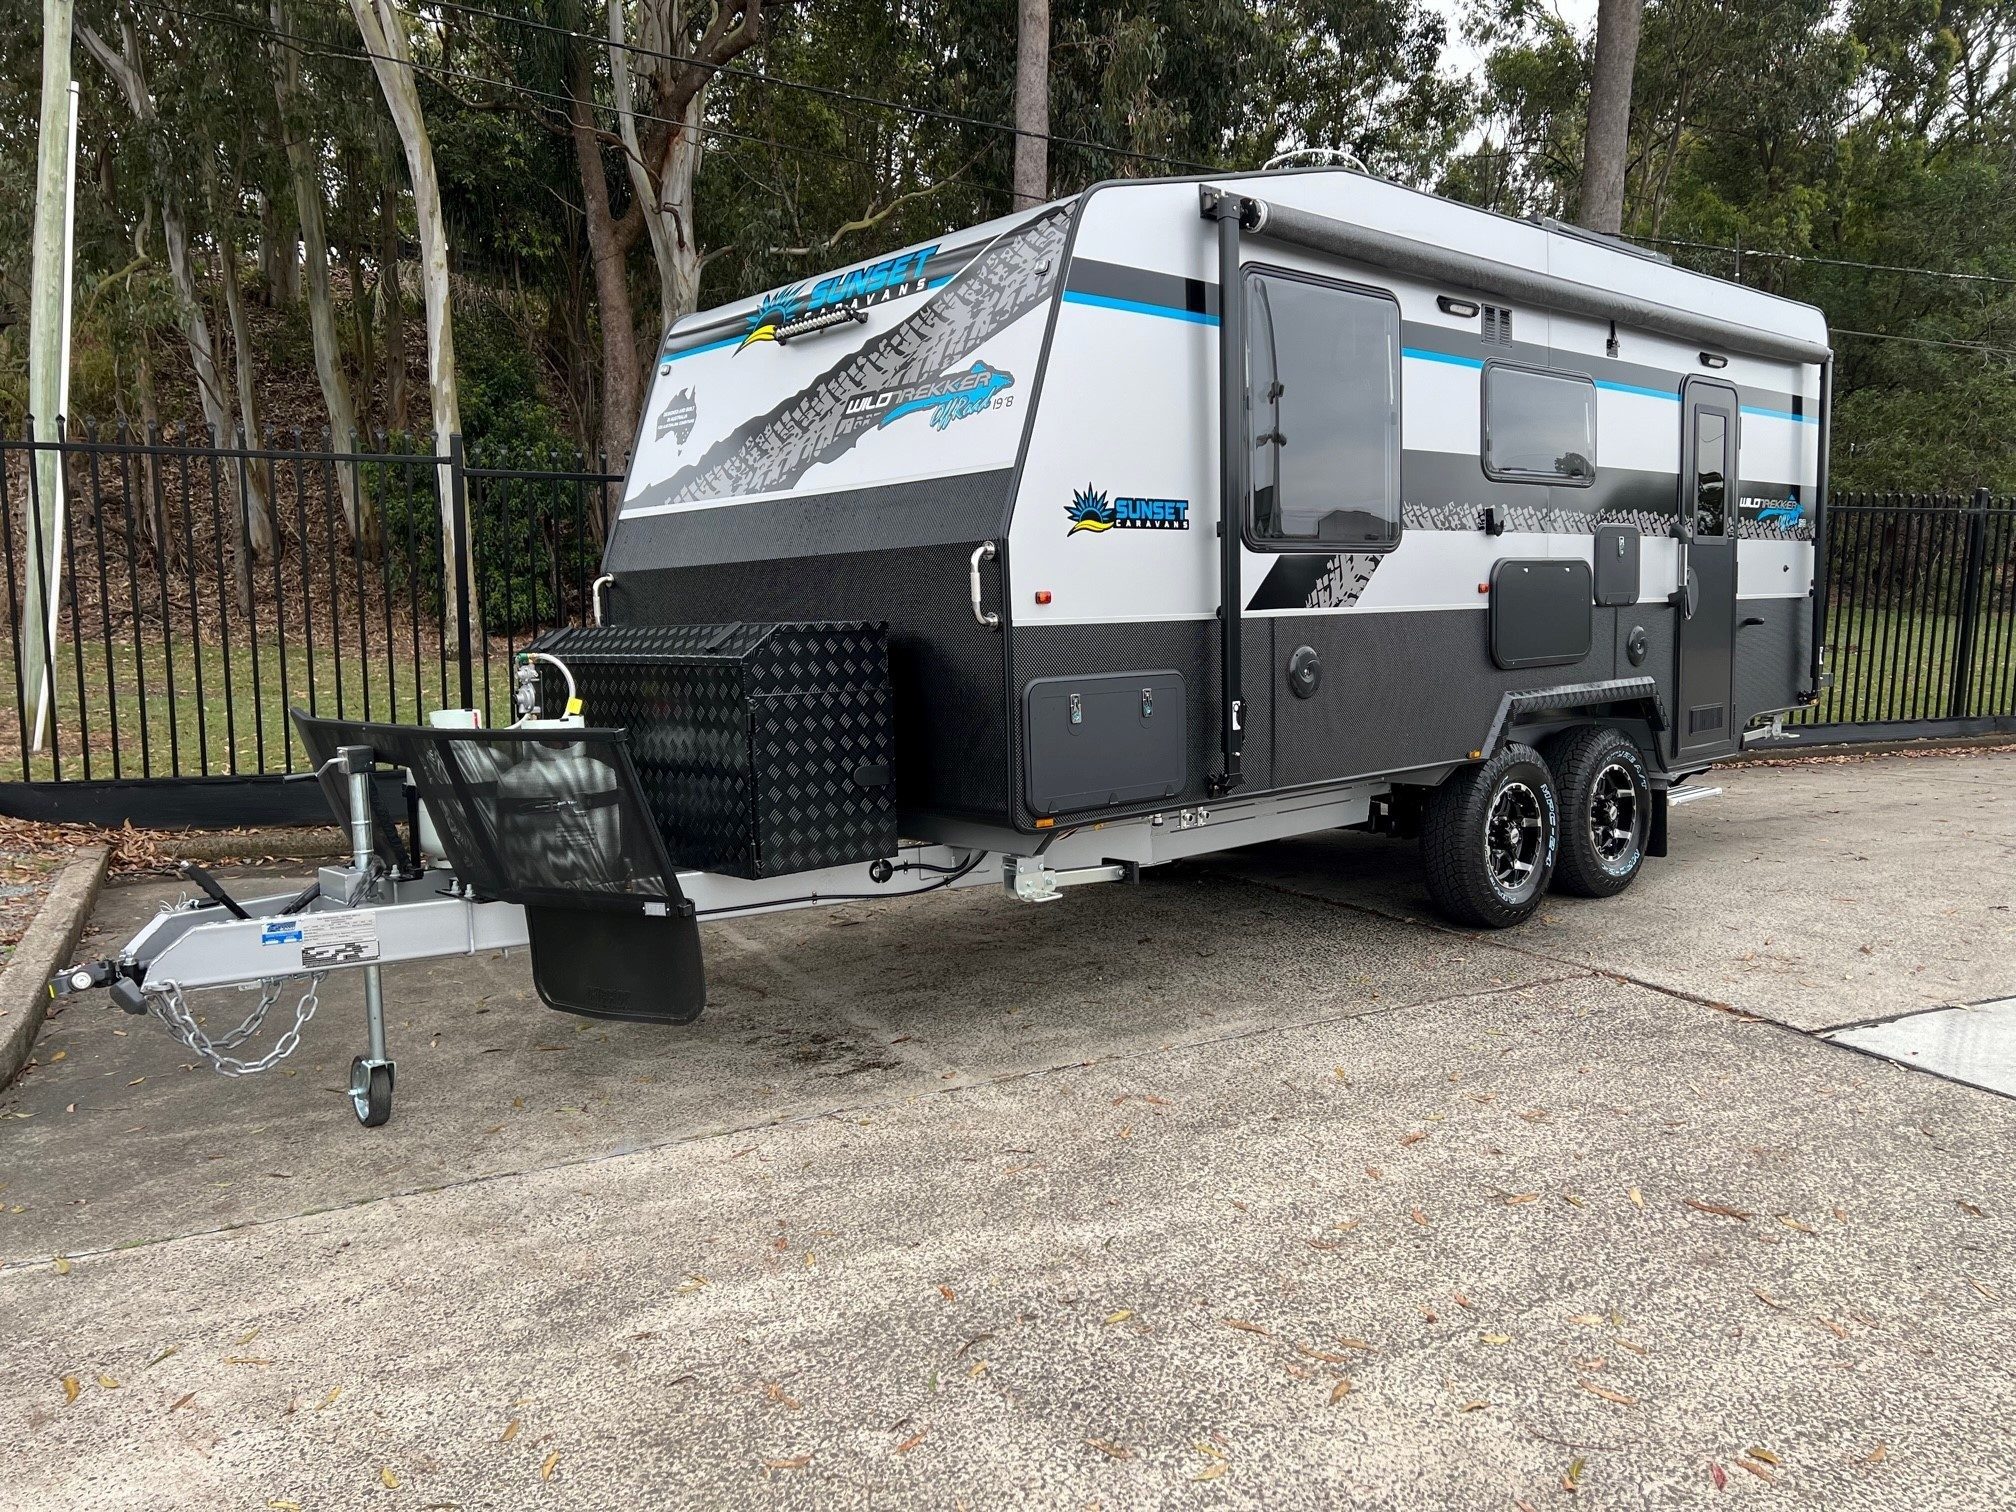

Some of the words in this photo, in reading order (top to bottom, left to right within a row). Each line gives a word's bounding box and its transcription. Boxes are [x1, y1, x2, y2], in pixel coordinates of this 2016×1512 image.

[807, 244, 942, 310] SUNSET
[1115, 499, 1188, 521] SUNSET
[1115, 519, 1188, 529] CARAVANS
